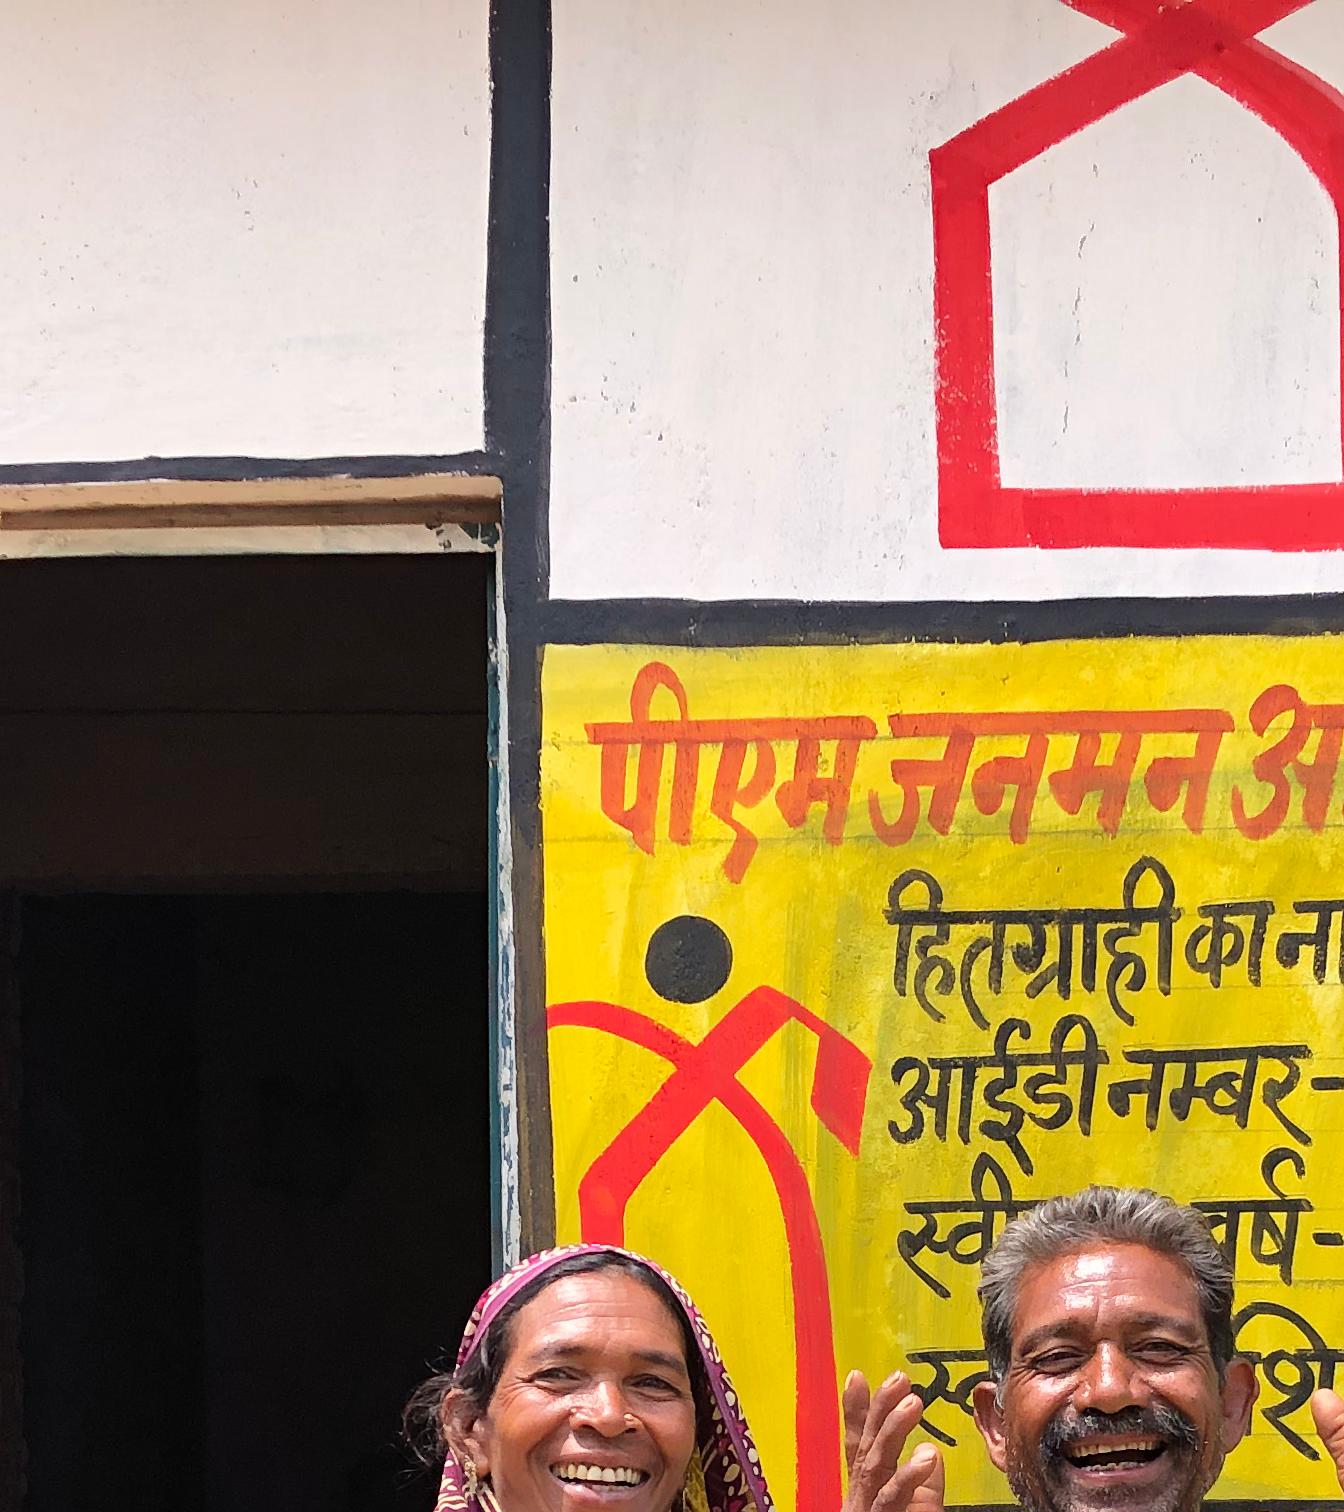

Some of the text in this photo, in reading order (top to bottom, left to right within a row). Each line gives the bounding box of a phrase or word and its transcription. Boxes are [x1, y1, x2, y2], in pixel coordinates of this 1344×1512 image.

[585, 661, 877, 884] पीएम
[868, 709, 1234, 848] जनमन
[884, 855, 1182, 1030] हितग्राही
[1183, 900, 1274, 986] का
[887, 1013, 1109, 1177] आईडी
